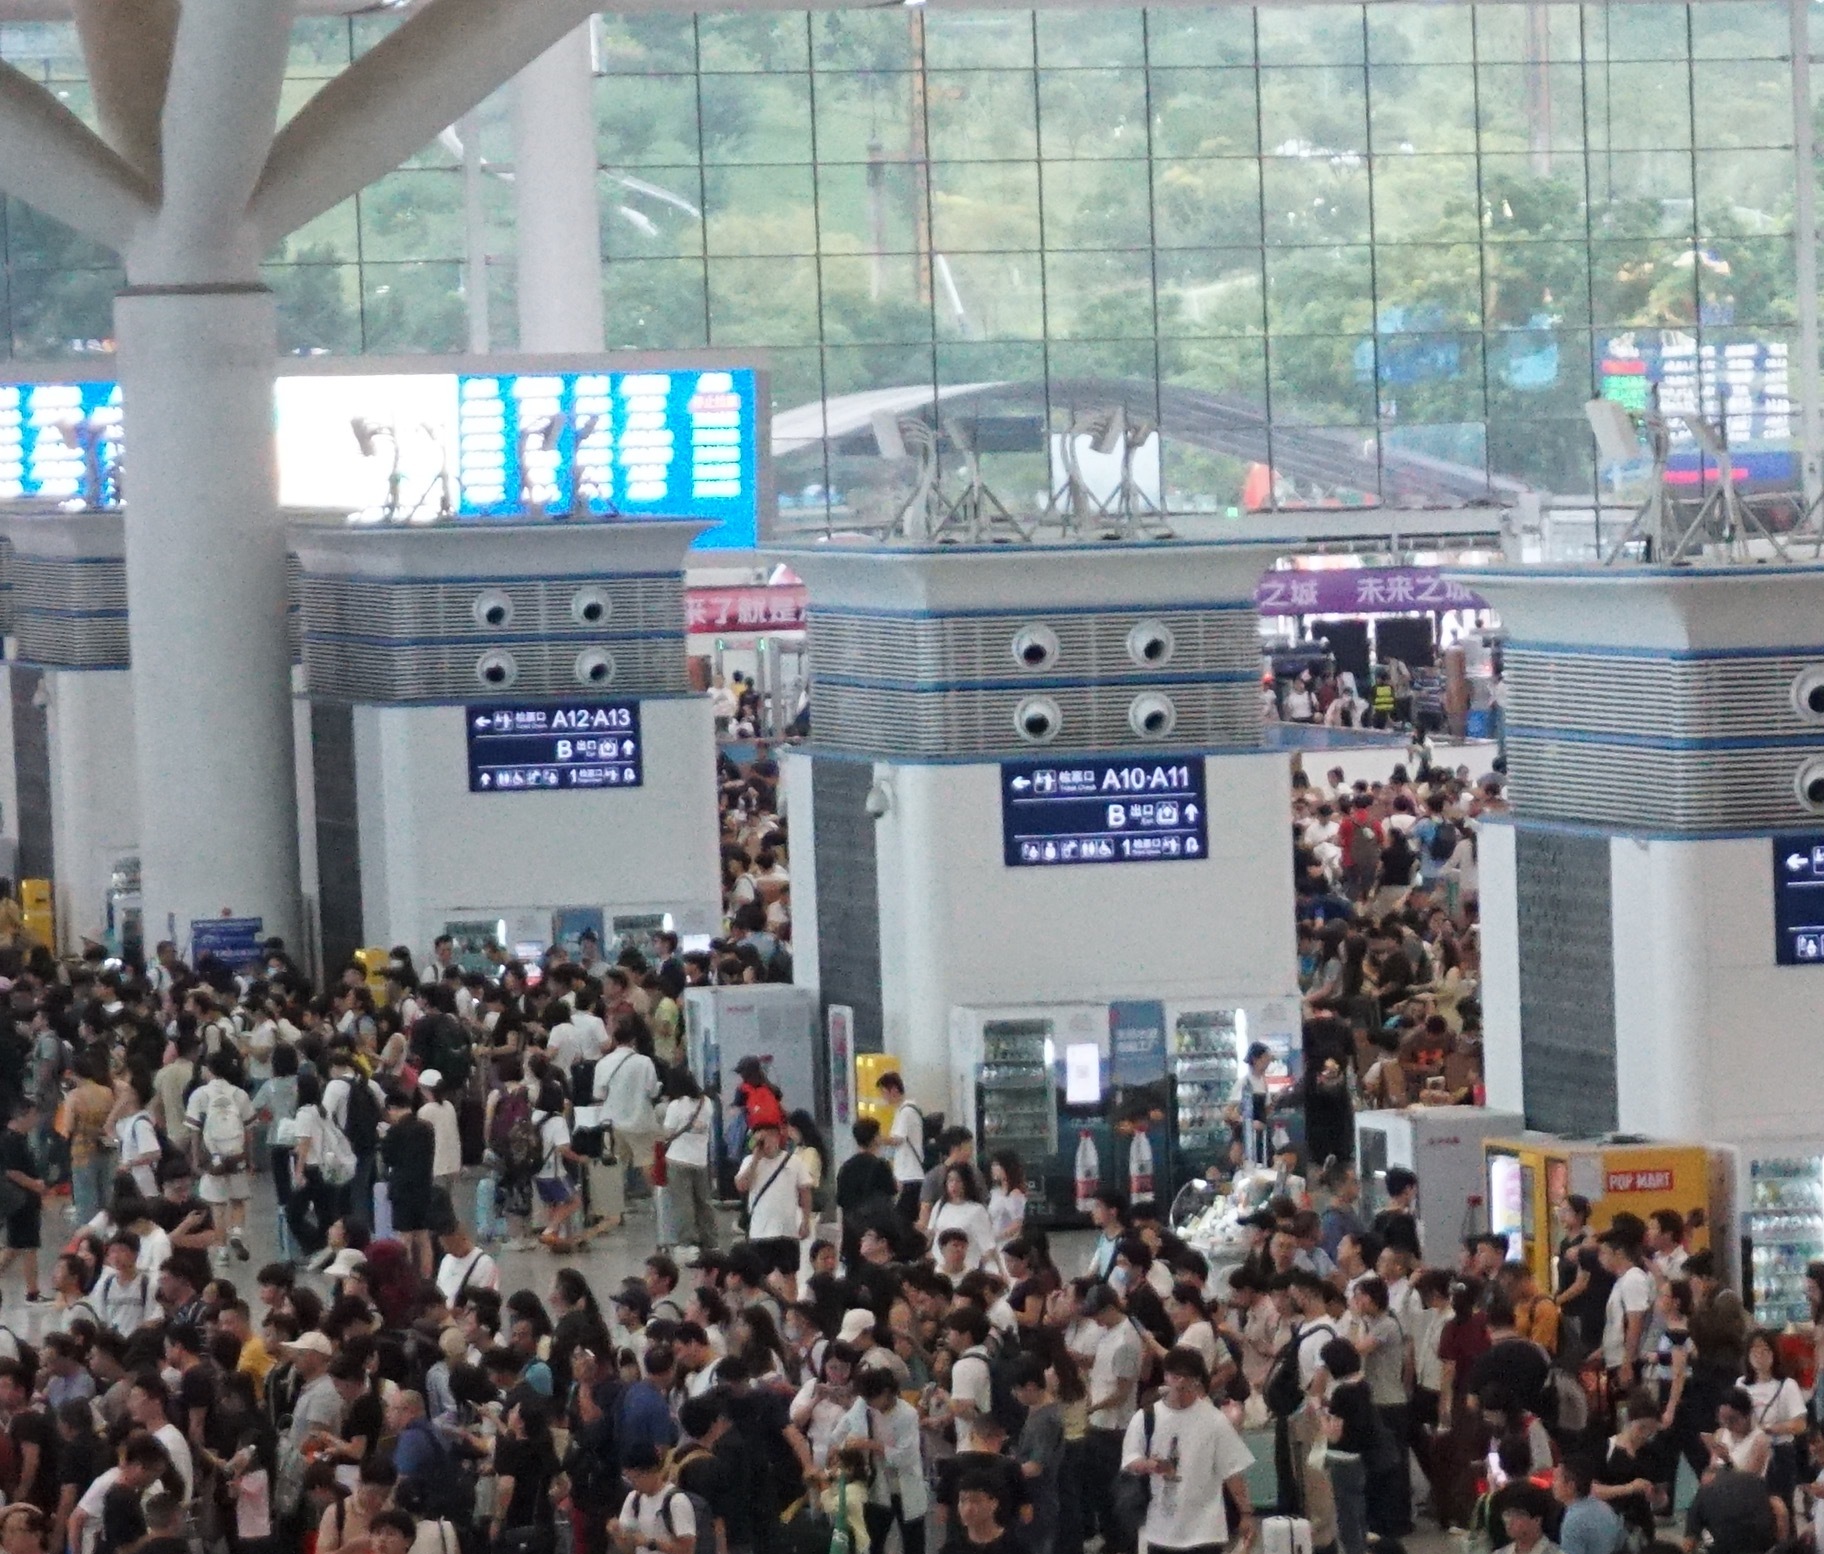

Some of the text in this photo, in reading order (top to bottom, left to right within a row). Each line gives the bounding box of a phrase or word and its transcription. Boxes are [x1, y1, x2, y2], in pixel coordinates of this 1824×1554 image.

[1253, 579, 1319, 606] 之城
[552, 708, 631, 728] A12·A13
[557, 740, 597, 759] B 出口
[570, 769, 577, 783] 1
[1102, 766, 1189, 790] A10·A11
[1107, 804, 1153, 828] B 出口
[1122, 839, 1131, 855] 1
[1609, 1172, 1670, 1191] POP MART
